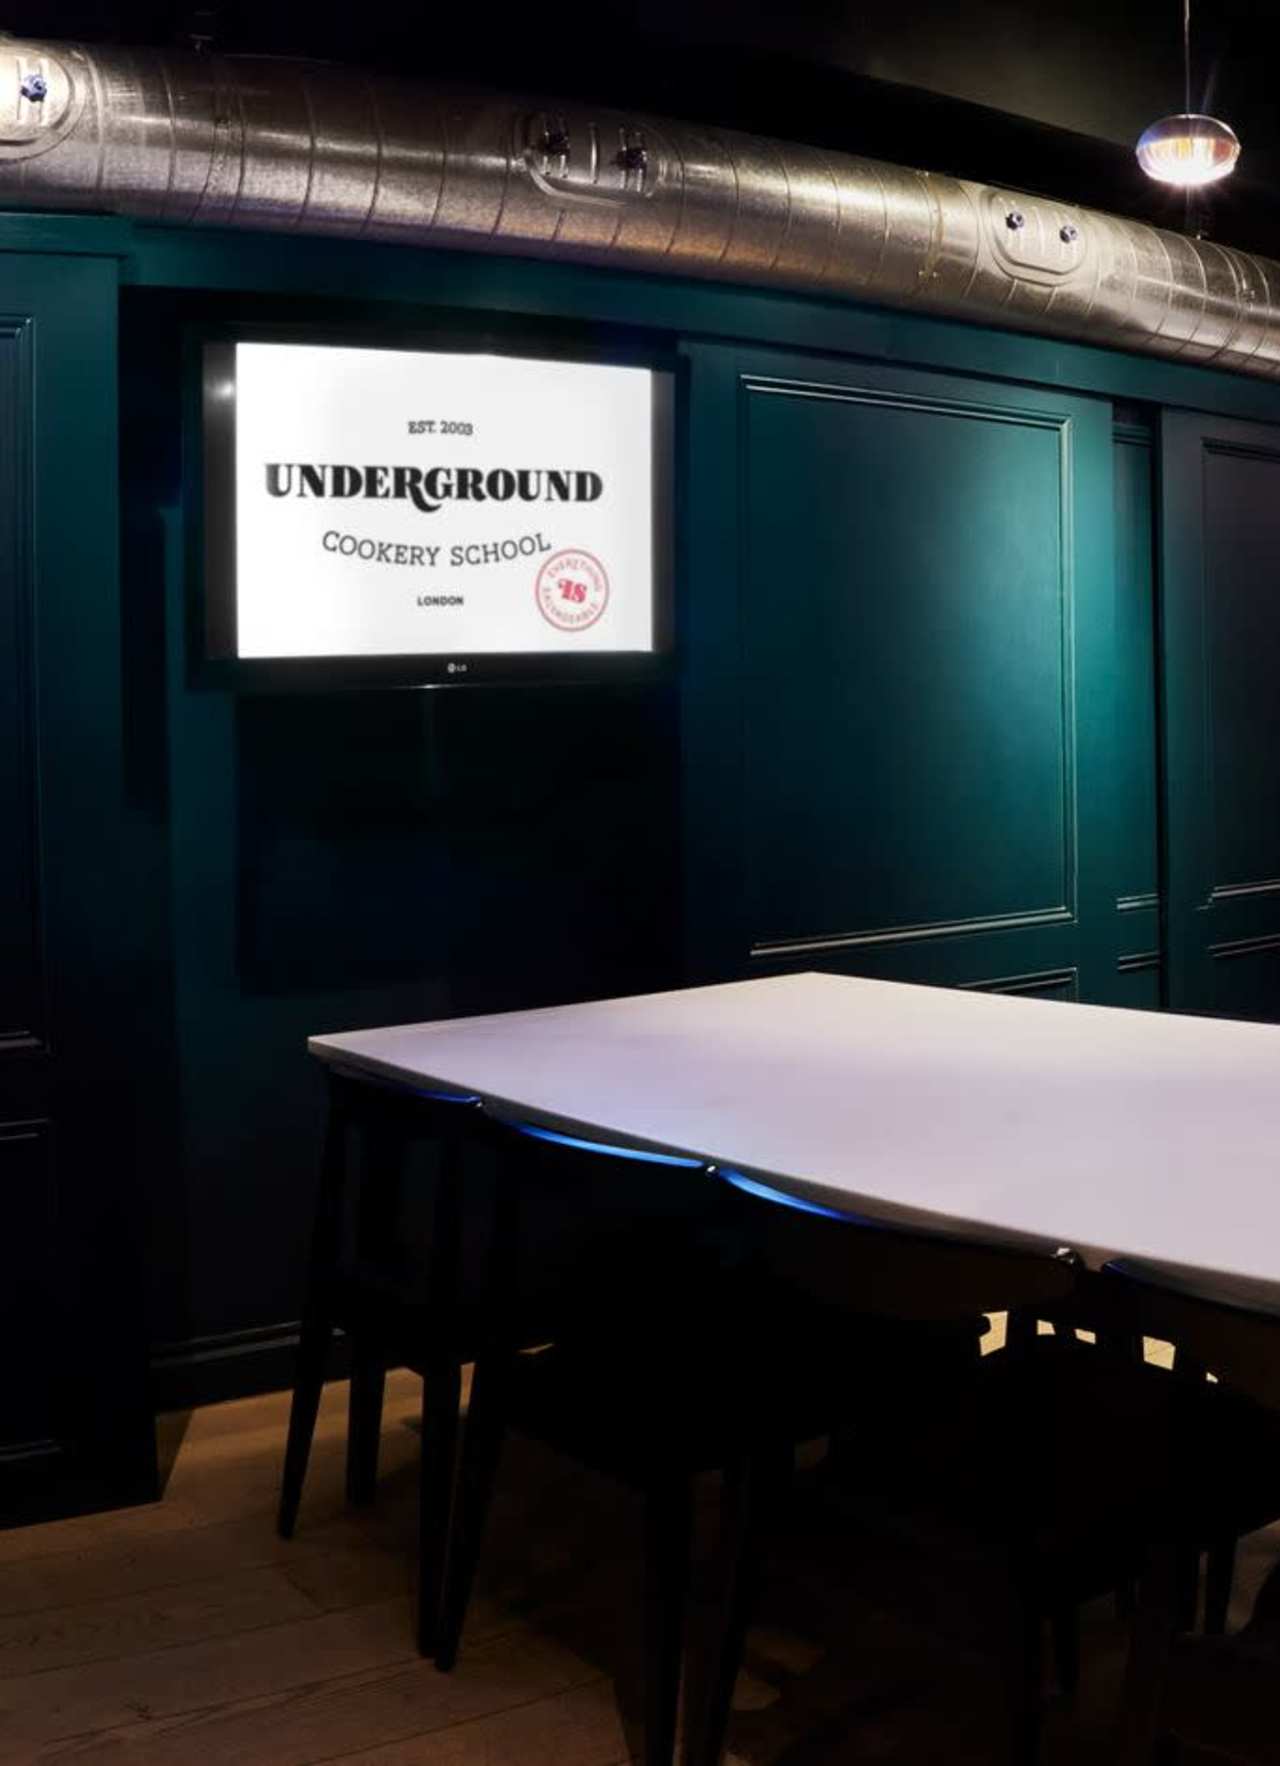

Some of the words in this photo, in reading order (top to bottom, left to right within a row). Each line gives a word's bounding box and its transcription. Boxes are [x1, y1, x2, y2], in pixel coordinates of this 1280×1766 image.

[440, 420, 473, 436] 2003
[264, 463, 603, 513] UNDERGROUND
[322, 530, 440, 567] COOKERY
[450, 532, 552, 567] SCHOOL
[416, 595, 465, 607] LONDON
